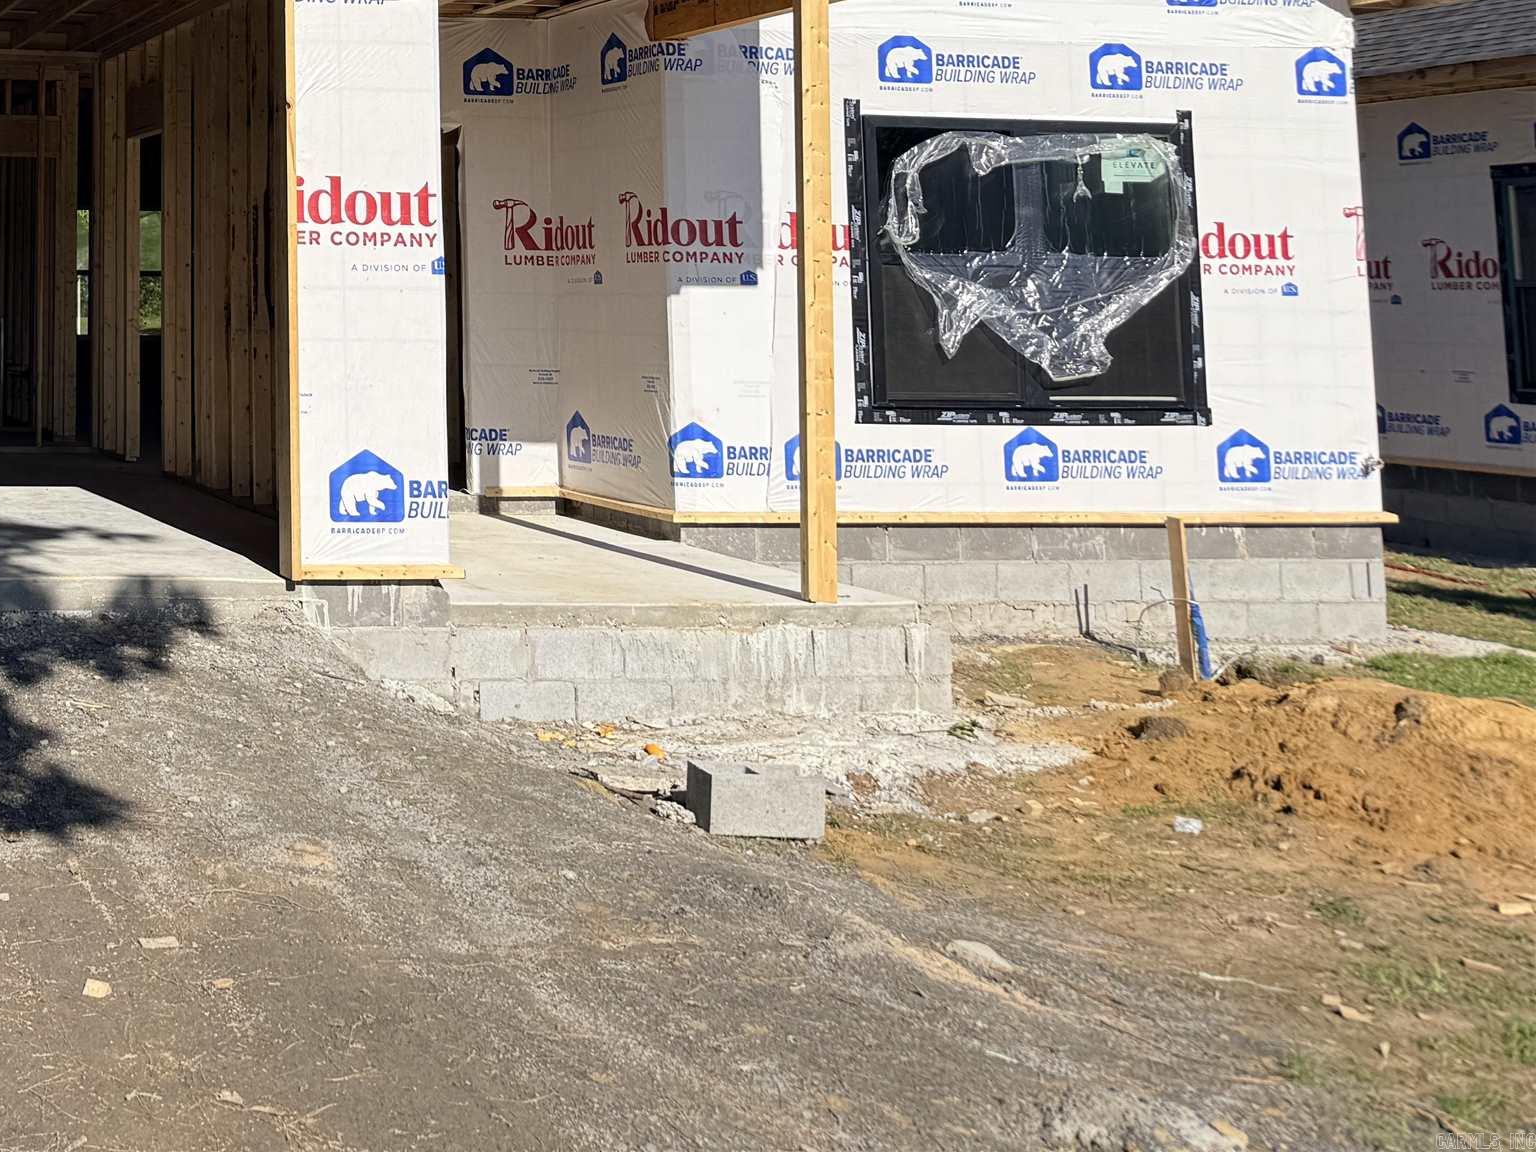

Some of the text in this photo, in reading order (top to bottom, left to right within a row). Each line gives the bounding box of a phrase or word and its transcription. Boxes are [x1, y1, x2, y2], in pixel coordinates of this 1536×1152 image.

[628, 42, 686, 62] BARRICADE
[628, 58, 703, 77] BUILDING WRAP
[936, 54, 1020, 69] BARRICADE
[1146, 61, 1228, 76] BARRICADE
[935, 68, 1036, 85] BUILDING WRAP
[1144, 76, 1243, 92] BUILDING WRAP
[296, 176, 437, 227] idout
[493, 198, 596, 252] Ridout
[618, 191, 744, 248] Ridout
[330, 231, 437, 248] COMPANY
[1201, 222, 1294, 260] dout
[560, 254, 596, 266] COMPANY
[626, 250, 744, 264] LUMBER COMPANY
[1422, 238, 1498, 279] Rido
[362, 264, 408, 272] DIVISION
[1218, 264, 1296, 276] COMPANY
[487, 442, 522, 456] WRAP
[592, 434, 634, 452] BARRICADE
[844, 448, 932, 464] BARRICADE
[1062, 450, 1148, 464] BARRICADE
[1274, 451, 1358, 464] BARRICADE
[726, 462, 766, 476] BUILD
[844, 464, 949, 479] BUILDING WRAP
[1061, 464, 1164, 480] BUILDING WRAP
[1274, 466, 1332, 480] BUILDING
[408, 502, 450, 518] BUIL
